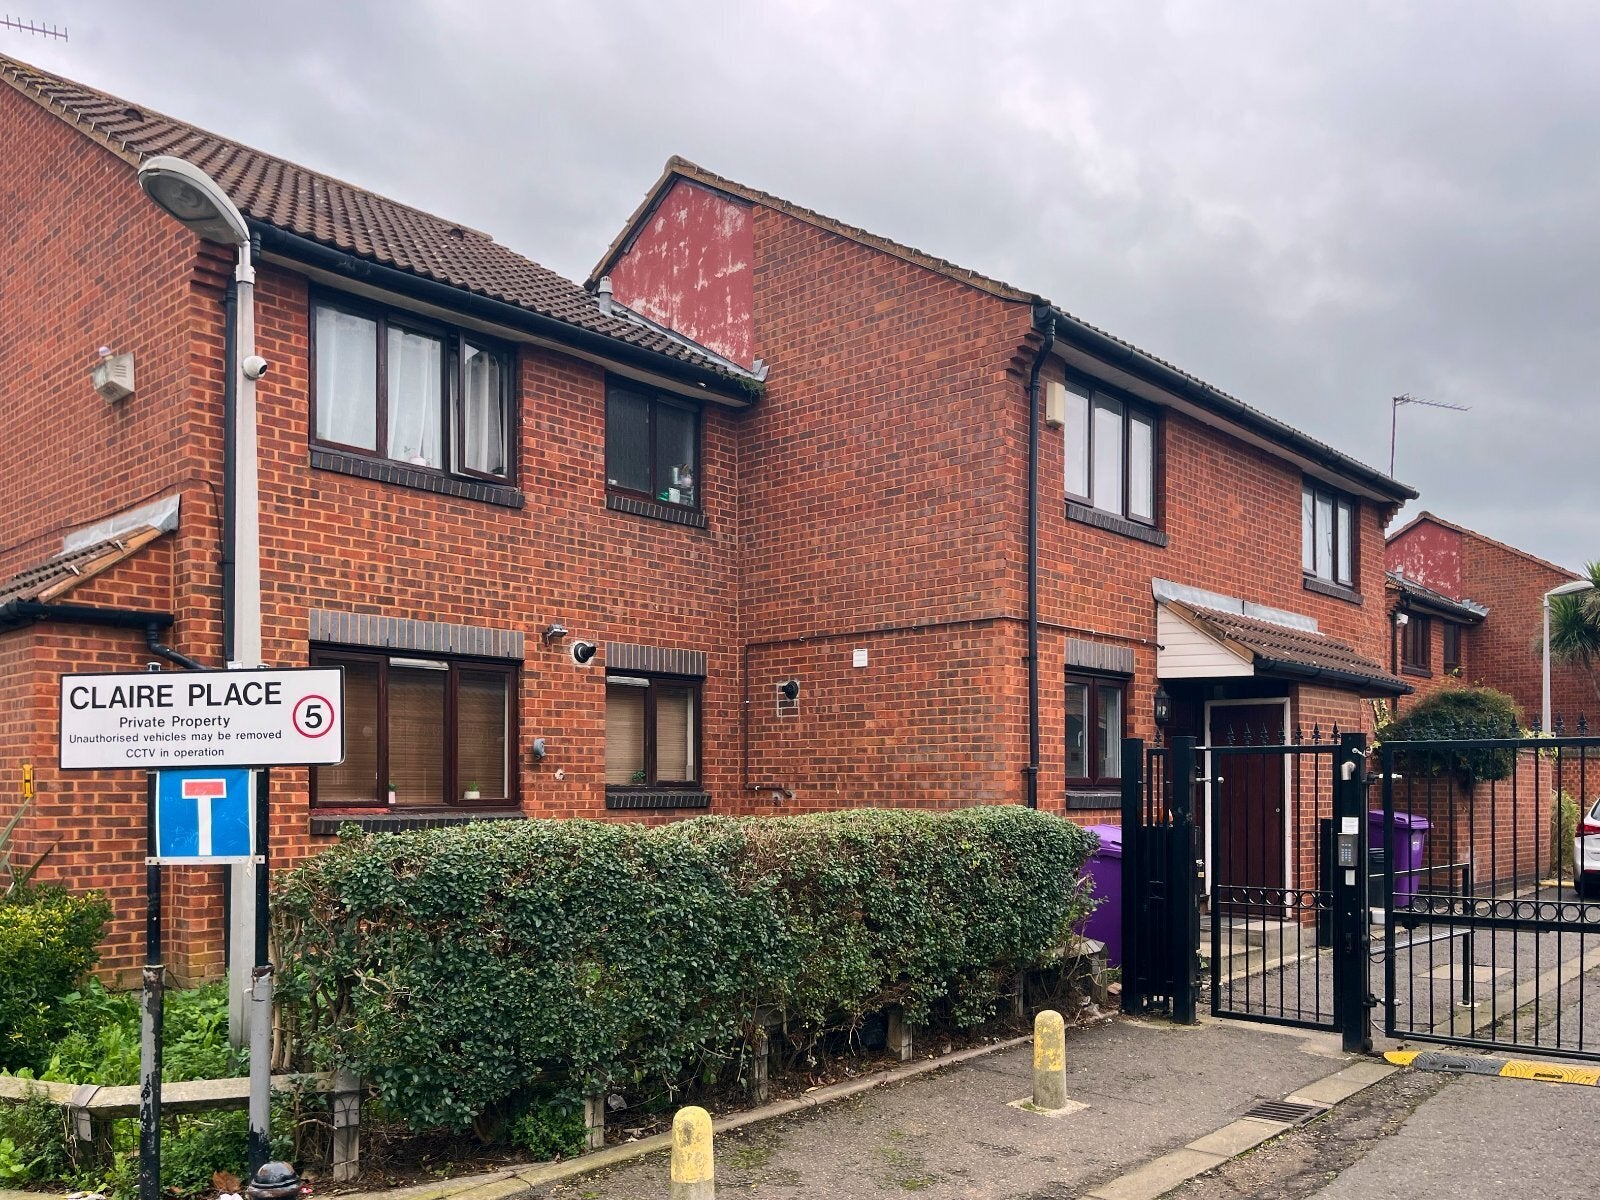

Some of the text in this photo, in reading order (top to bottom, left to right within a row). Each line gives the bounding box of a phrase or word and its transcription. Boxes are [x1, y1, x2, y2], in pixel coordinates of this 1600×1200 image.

[70, 682, 281, 710] CLAIRE PLACE
[119, 715, 231, 729] Private Property
[304, 704, 323, 729] 5
[69, 729, 282, 744] Unauthorised vehicles may be removed
[125, 747, 225, 759] CCTV in operation
